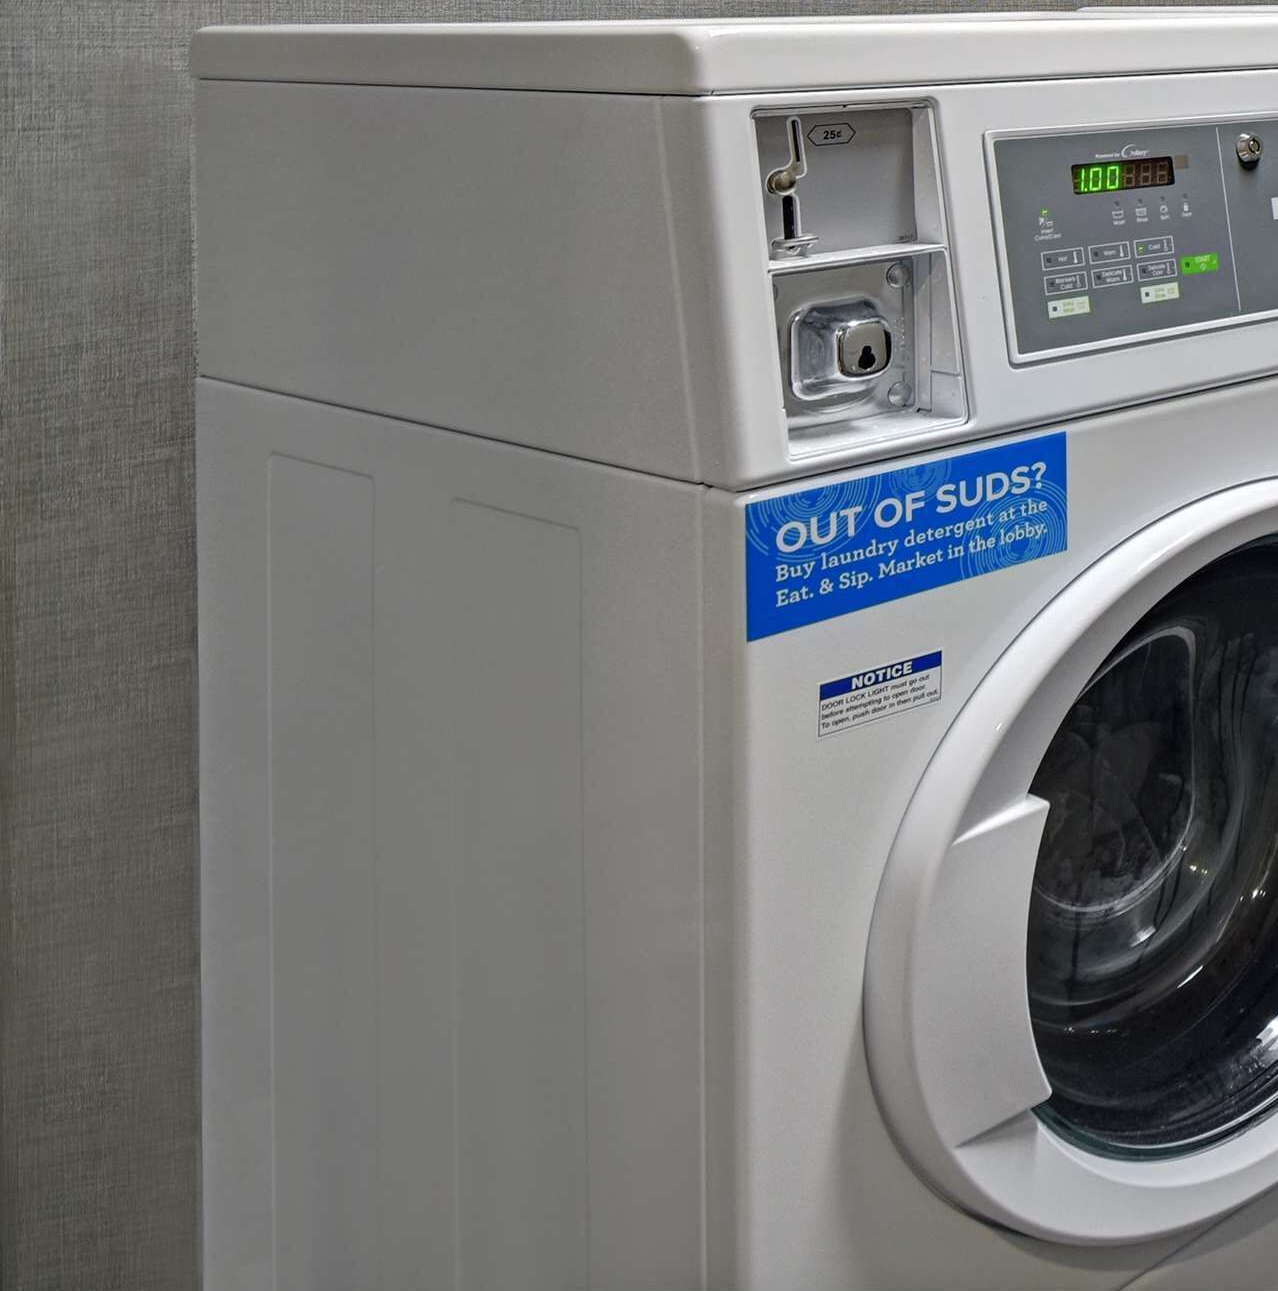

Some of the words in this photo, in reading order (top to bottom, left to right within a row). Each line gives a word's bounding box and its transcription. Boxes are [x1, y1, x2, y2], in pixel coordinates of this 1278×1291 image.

[1080, 165, 1120, 193] 1.00
[776, 506, 862, 553] OUT
[874, 491, 925, 528] OF
[936, 462, 1046, 513] SUDS?
[776, 561, 815, 582] Buy
[821, 539, 899, 569] laundry
[904, 513, 994, 547] detergent
[999, 506, 1016, 522] at
[1021, 498, 1048, 516] the
[776, 585, 814, 607] Eat.
[819, 578, 834, 595] &
[838, 571, 874, 589] Sip.
[878, 549, 944, 579] Market
[947, 544, 965, 560] in
[968, 535, 996, 553] the
[1000, 522, 1048, 545] lobby.
[851, 661, 913, 689] NOTICE
[821, 699, 844, 711] DOOR
[845, 693, 866, 704] LOCK
[868, 686, 889, 698] LIGHT
[890, 680, 907, 691] must
[821, 709, 844, 720] before
[883, 694, 891, 702] to
[891, 689, 908, 699] open
[821, 721, 831, 729] To
[852, 709, 870, 721] push
[871, 704, 887, 714] door
[888, 701, 896, 709] in
[896, 696, 912, 706] then
[912, 691, 925, 703] pull
